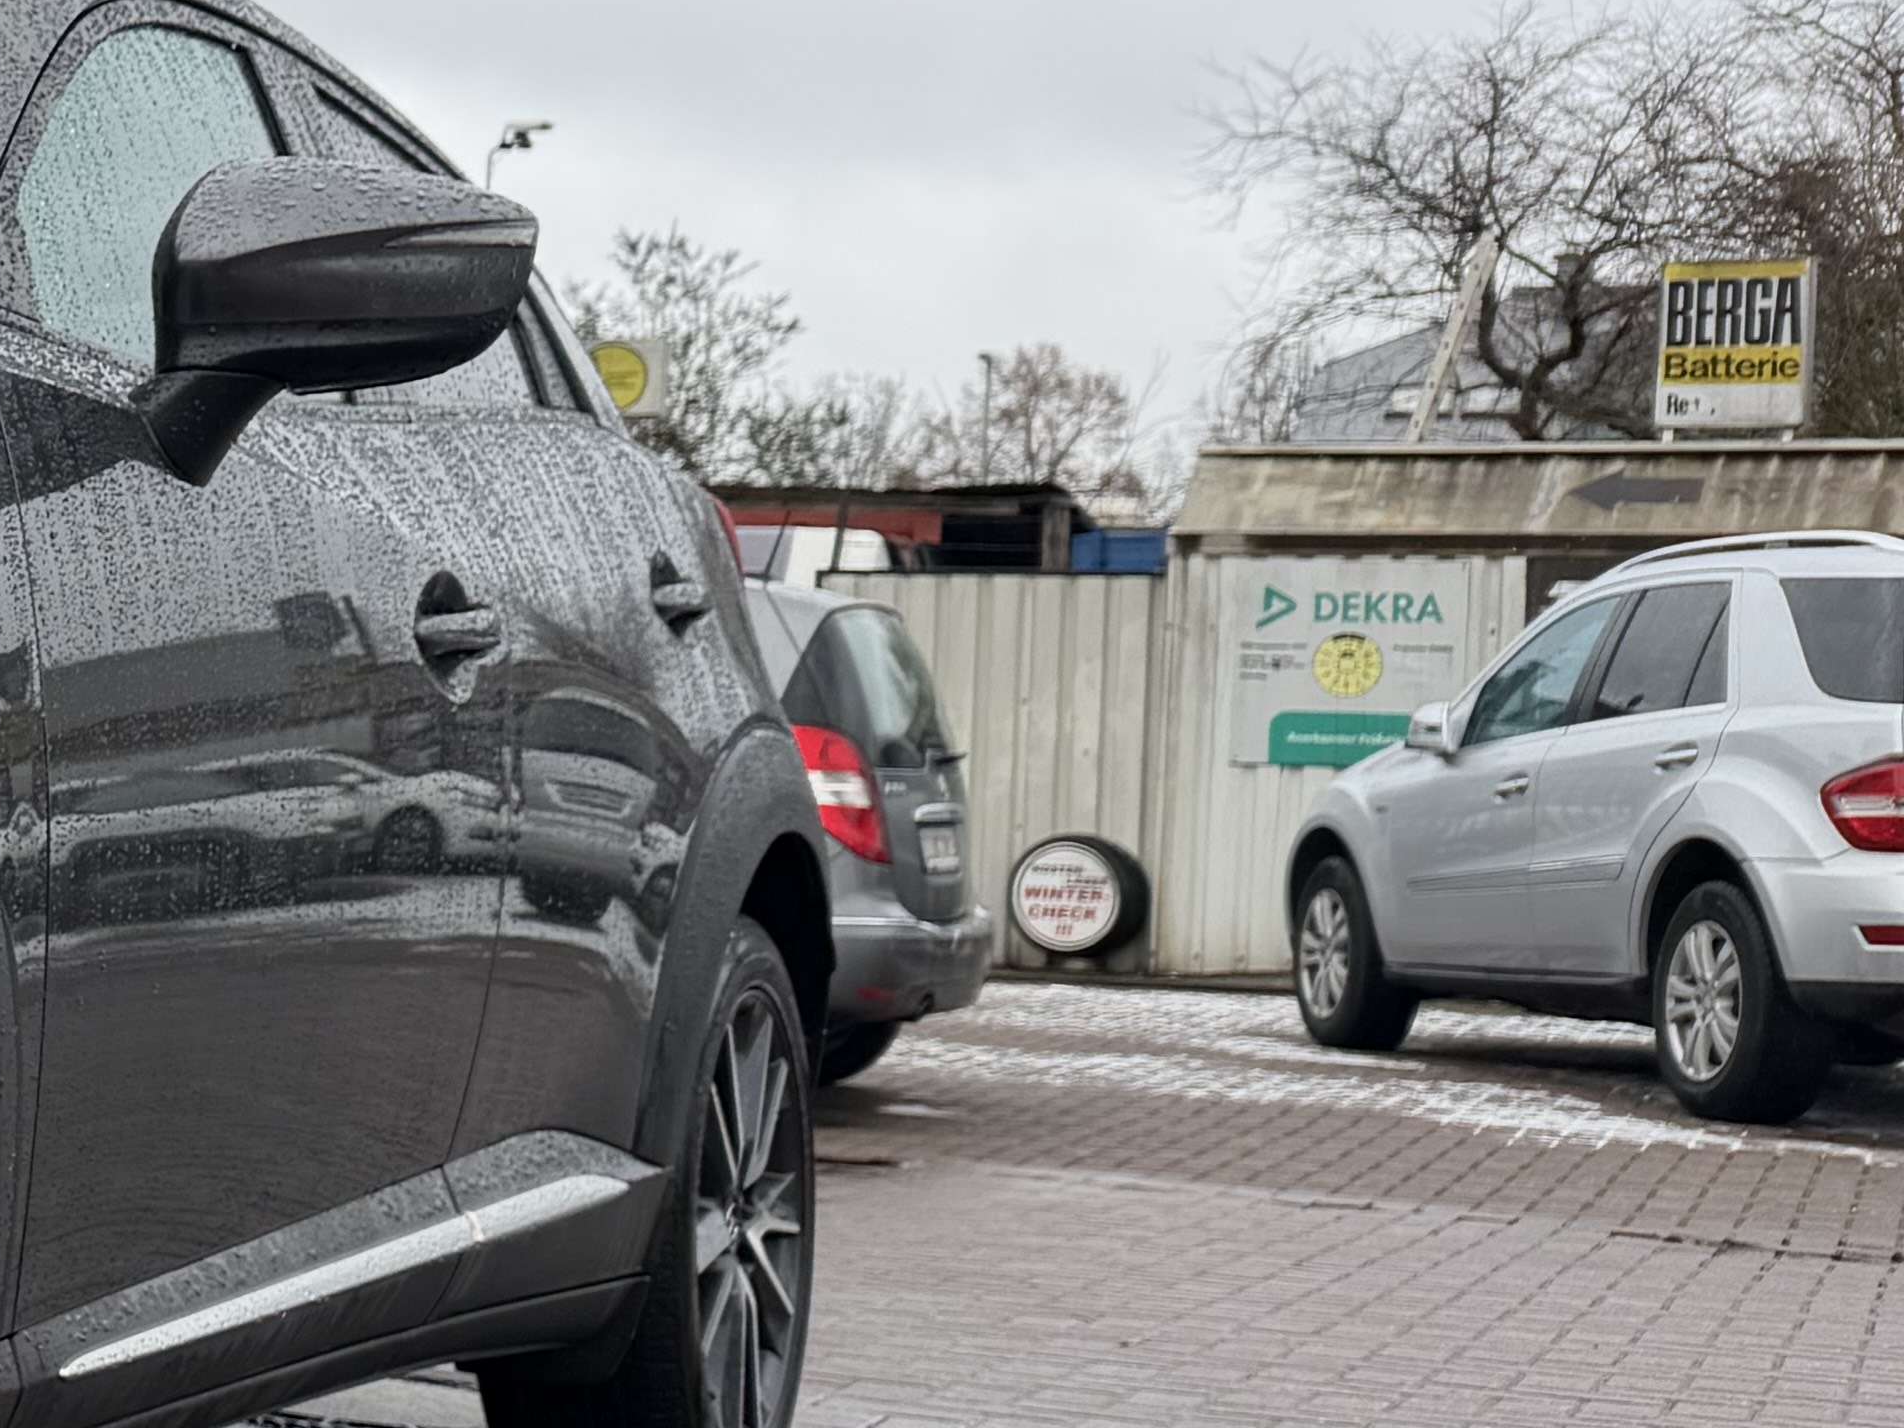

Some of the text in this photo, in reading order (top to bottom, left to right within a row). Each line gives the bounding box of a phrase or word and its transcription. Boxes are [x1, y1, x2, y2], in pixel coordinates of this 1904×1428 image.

[1665, 277, 1802, 347] BERGA
[1663, 350, 1801, 380] Batterie
[1313, 590, 1445, 624] DEKRA
